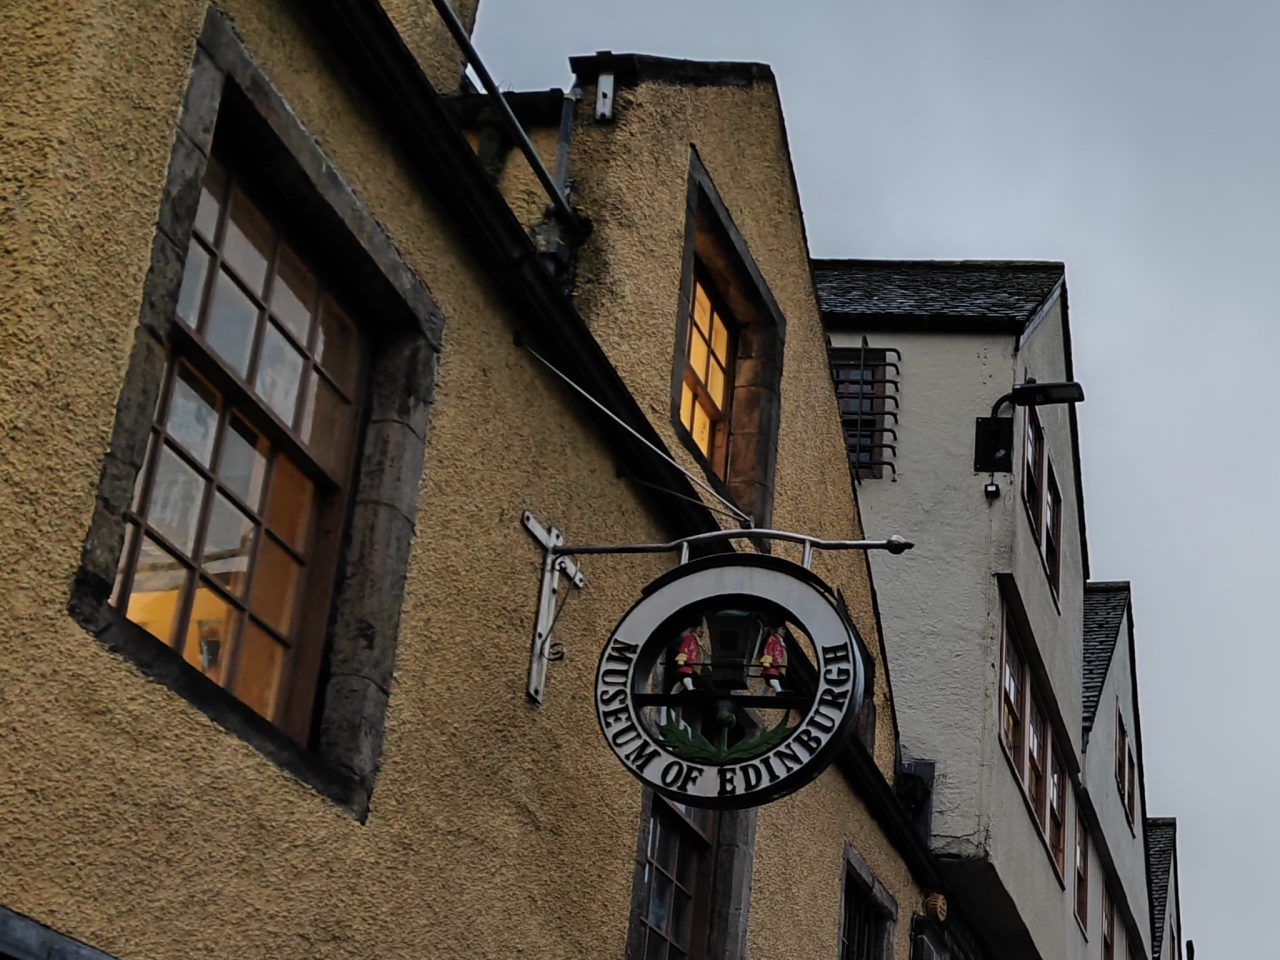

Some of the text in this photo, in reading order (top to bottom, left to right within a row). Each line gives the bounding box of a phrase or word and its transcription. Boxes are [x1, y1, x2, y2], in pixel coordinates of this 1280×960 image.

[600, 638, 854, 796] MUSEUM OF EDINBURGH
